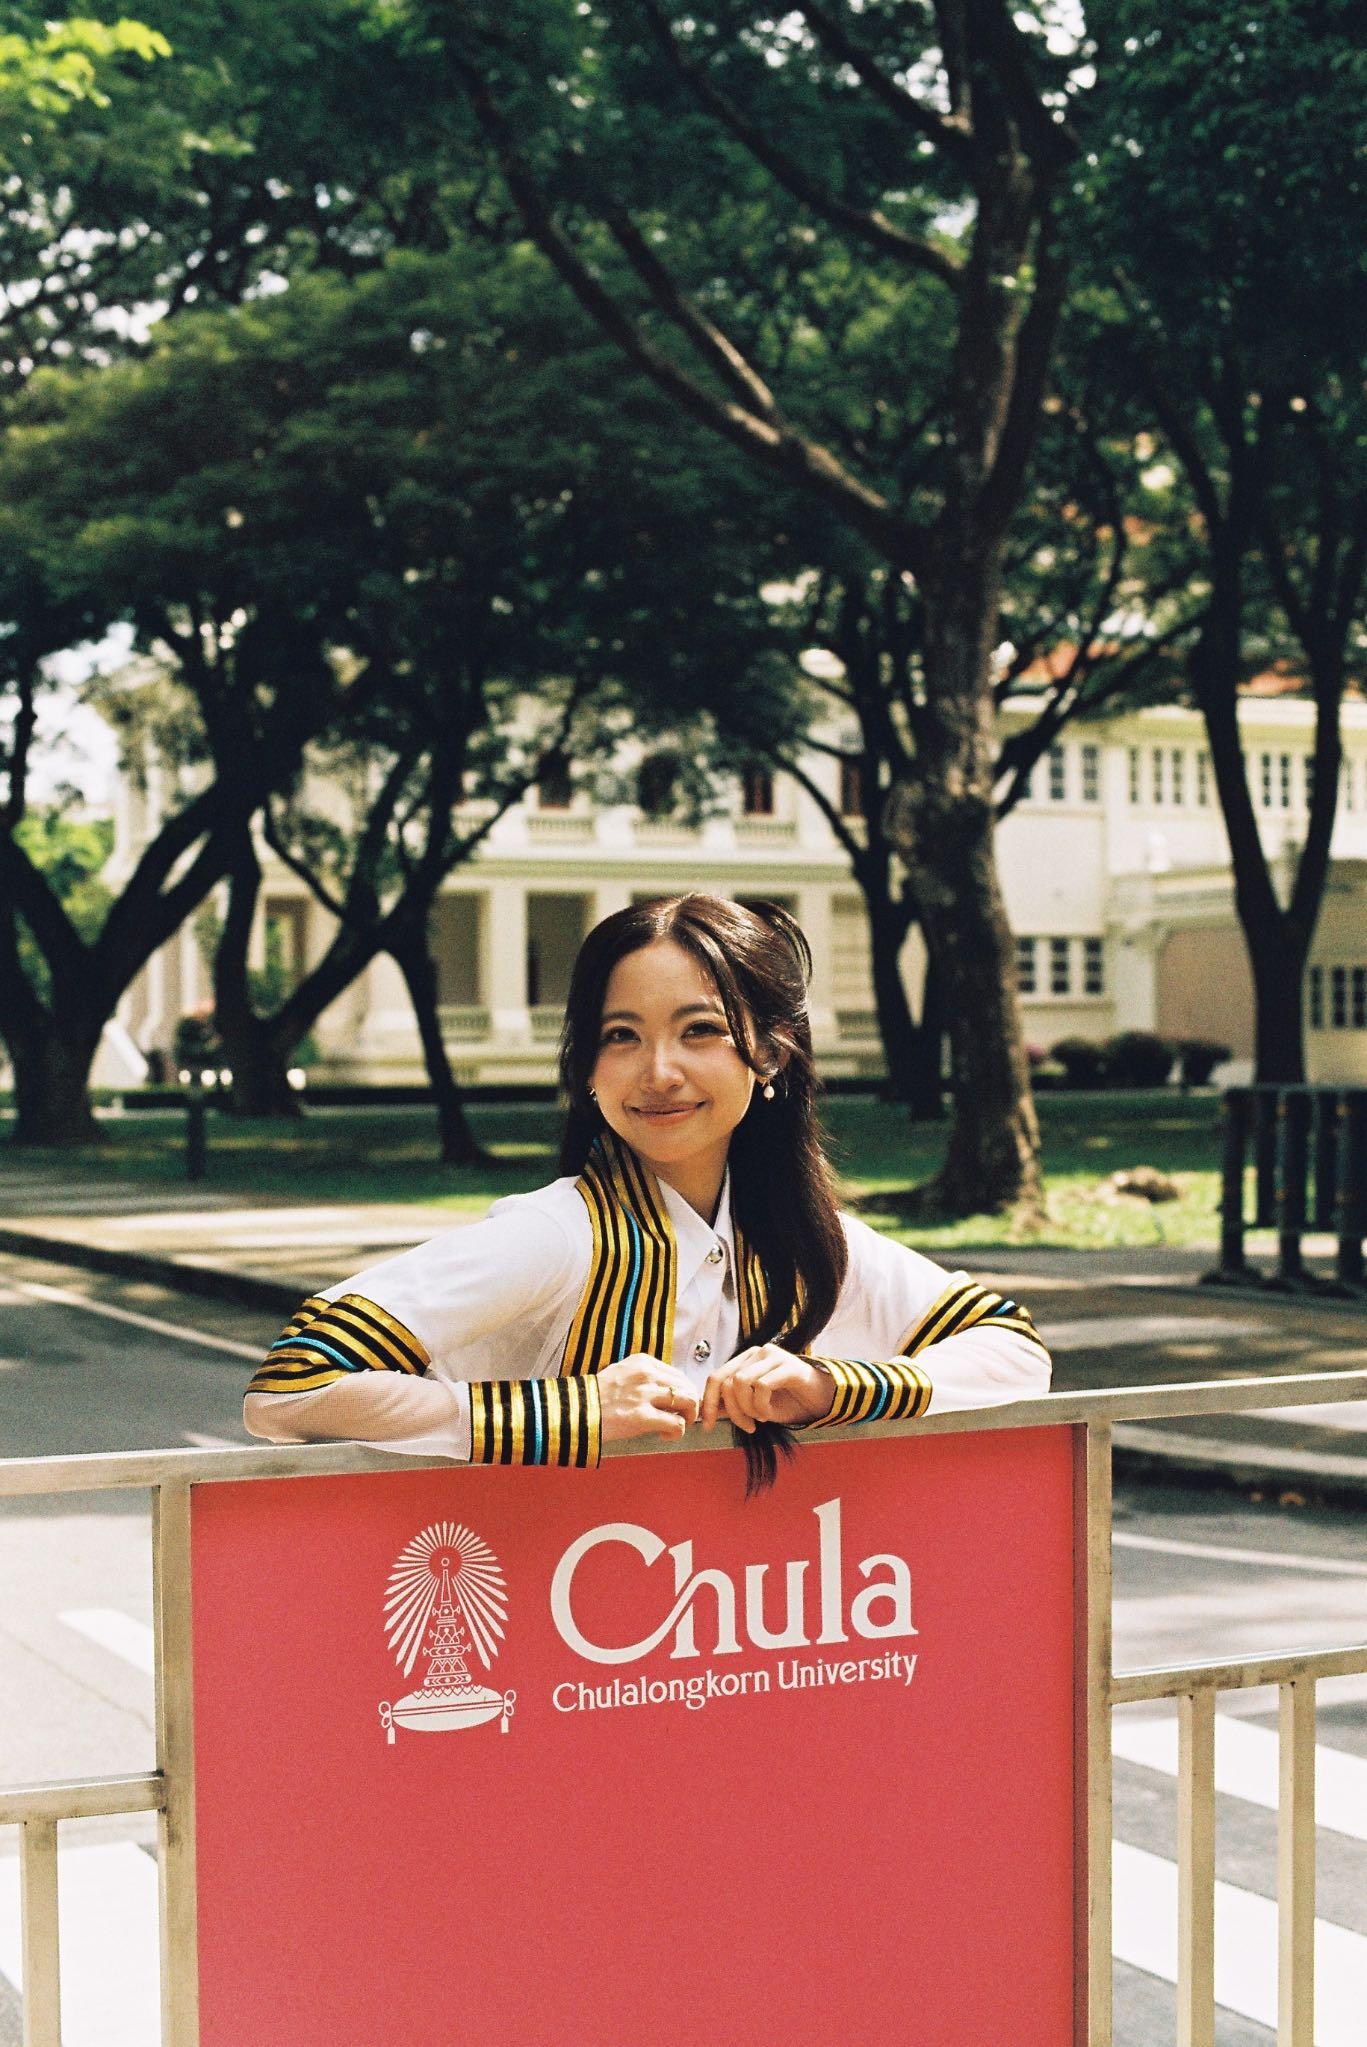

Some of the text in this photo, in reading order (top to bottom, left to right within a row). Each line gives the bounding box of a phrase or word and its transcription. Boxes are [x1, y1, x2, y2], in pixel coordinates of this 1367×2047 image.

[550, 1497, 919, 1665] Chula
[552, 1653, 919, 1713] Chulalongkorn University
